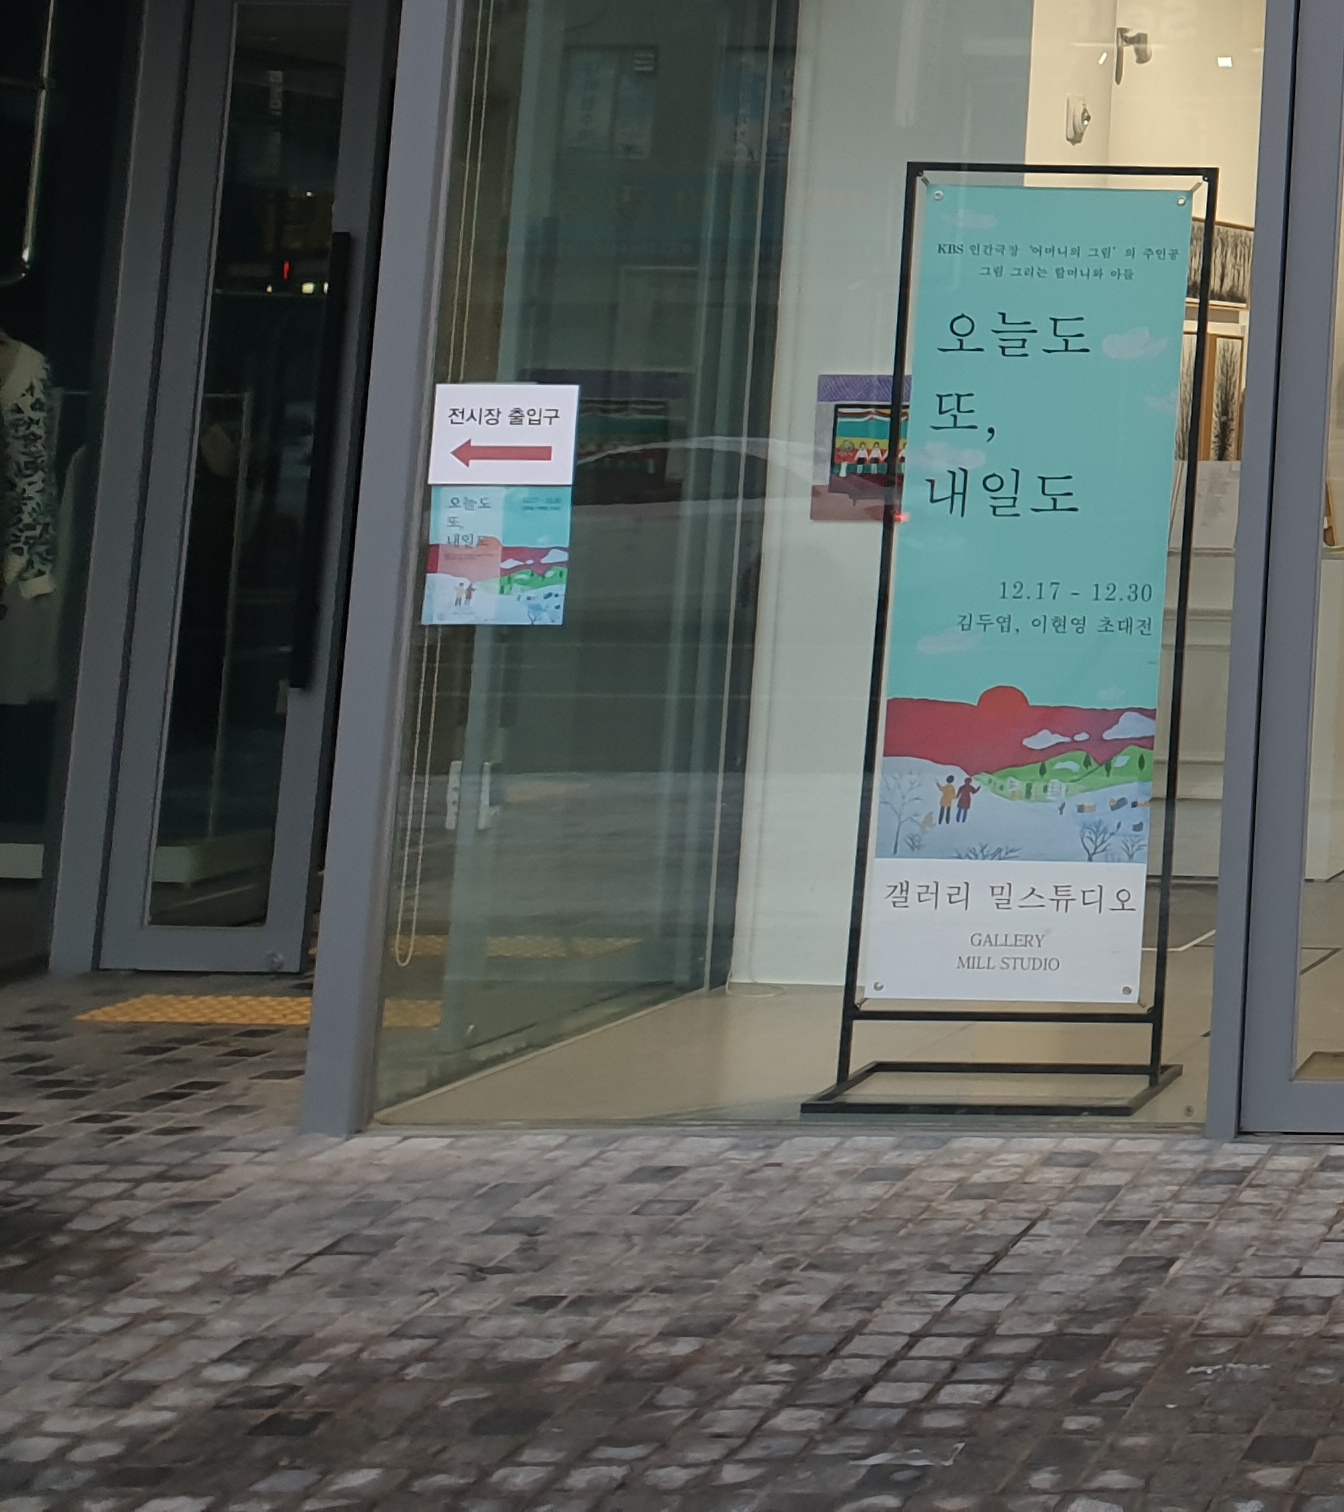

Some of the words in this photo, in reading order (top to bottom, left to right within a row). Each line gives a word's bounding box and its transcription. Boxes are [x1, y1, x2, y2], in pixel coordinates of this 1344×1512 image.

[937, 243, 964, 255] KBS
[1125, 247, 1136, 260] 의
[1143, 248, 1180, 261] 주인공
[979, 265, 1004, 278] 그림
[1010, 266, 1048, 279] 그리는
[936, 310, 1092, 359] 오늘도
[448, 407, 502, 427] 전시장
[507, 407, 562, 427] 출입구
[929, 392, 996, 443] 또,
[924, 466, 1081, 518] 내일도
[448, 496, 492, 510] 오늘도
[999, 580, 1061, 602] 12.17
[1091, 582, 1154, 603] 12.30
[956, 612, 1021, 635] 김두엽,
[1031, 615, 1088, 635] 이현영
[1096, 616, 1153, 637] 초대전
[884, 879, 972, 912] 갤러리
[989, 881, 1137, 914] 밀스튜디오
[969, 932, 1046, 949] GALLERY
[956, 955, 996, 972] MILL
[999, 956, 1061, 972] STUDIO
